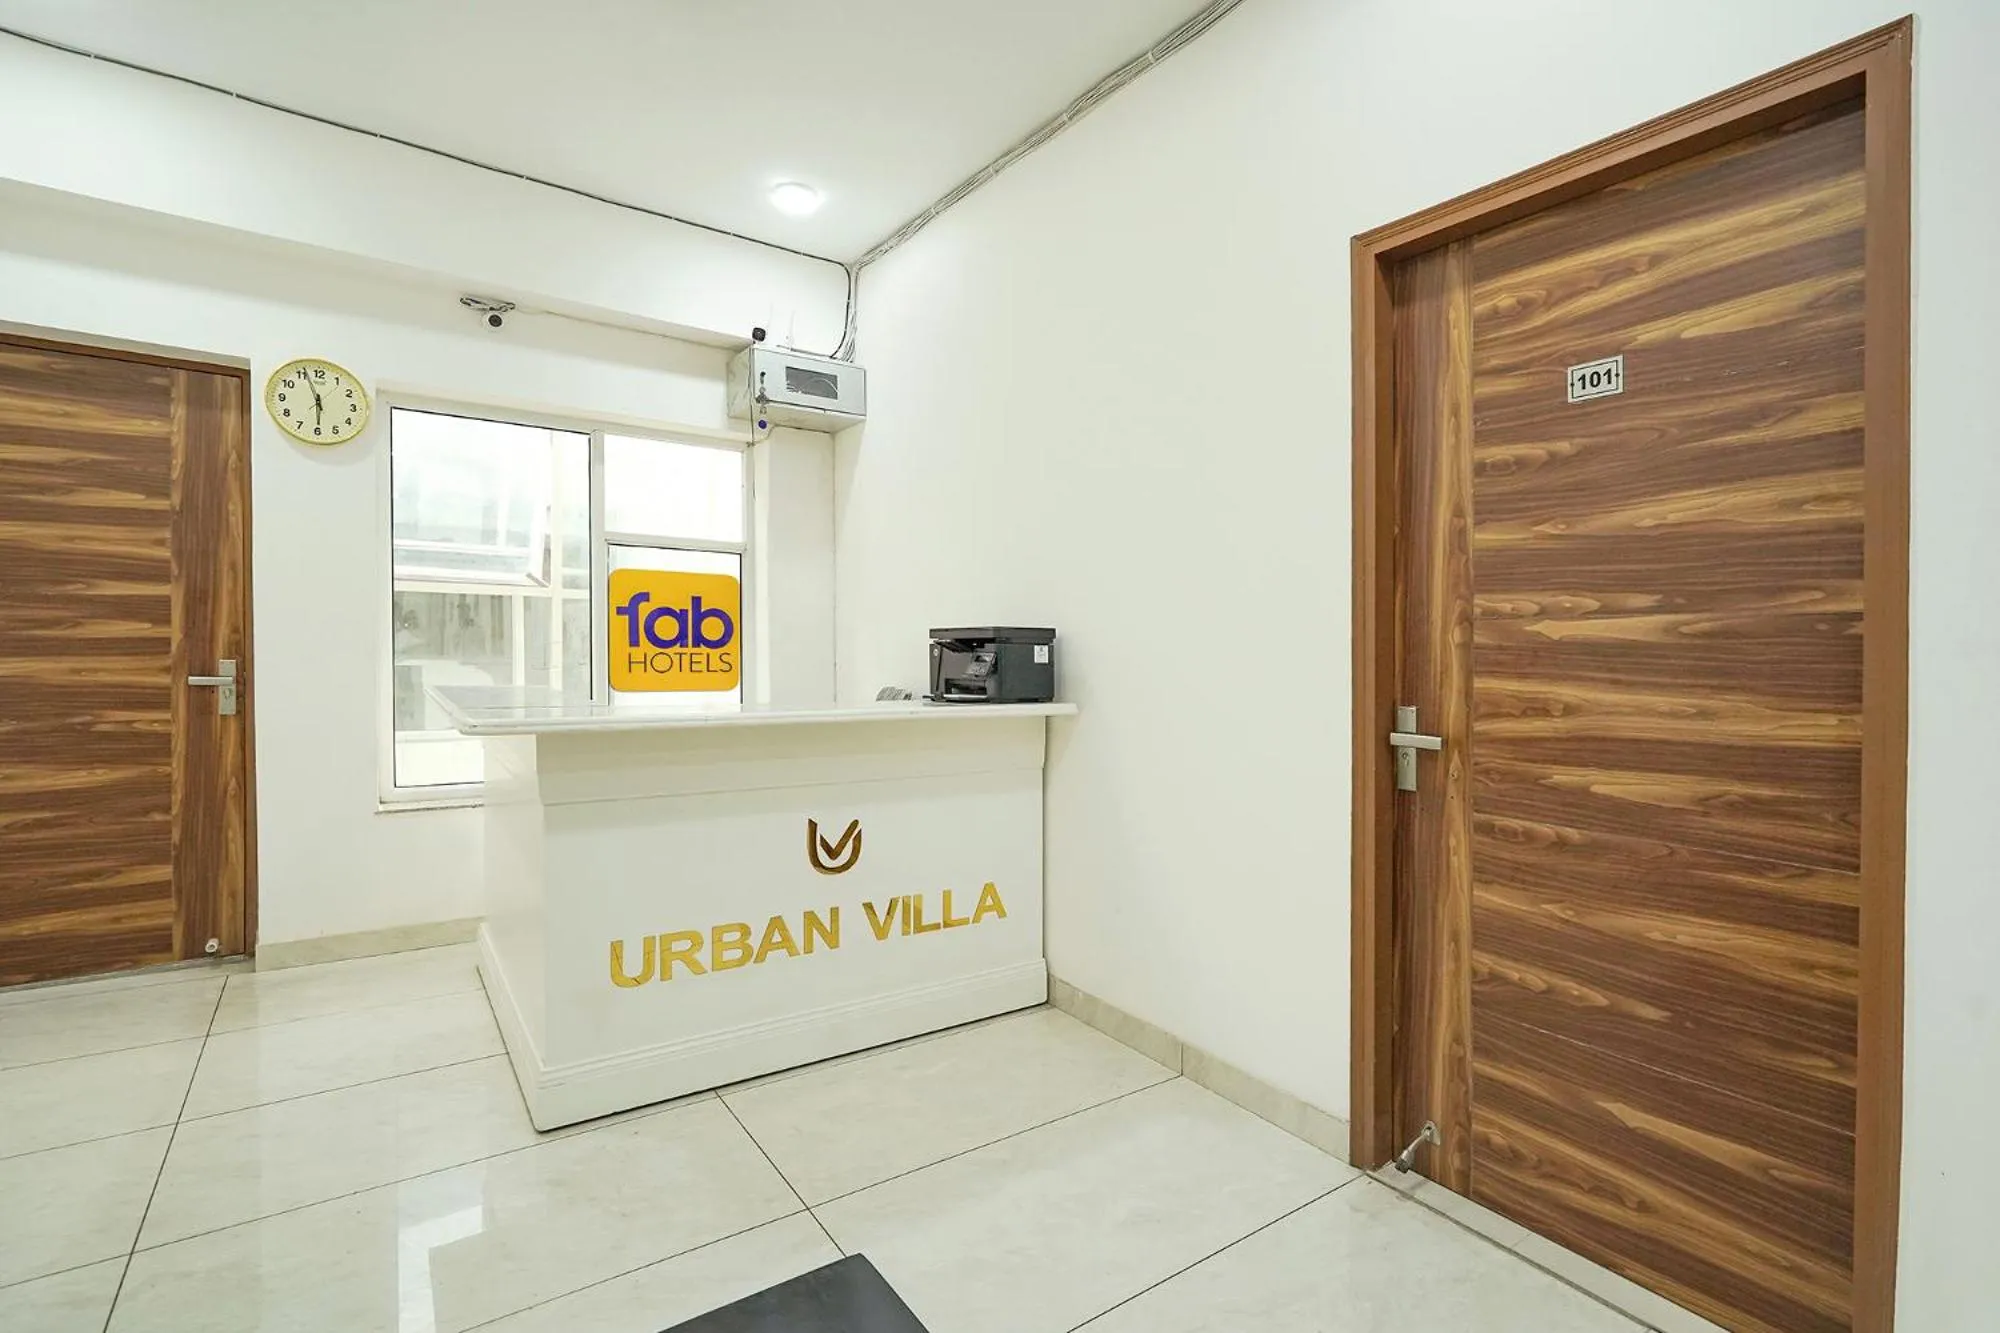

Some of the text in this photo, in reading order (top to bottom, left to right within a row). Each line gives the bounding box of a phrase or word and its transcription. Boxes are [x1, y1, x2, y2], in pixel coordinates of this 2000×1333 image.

[296, 369, 307, 380] 11
[313, 369, 326, 380] 12
[1578, 368, 1612, 390] 101
[282, 379, 295, 389] 10
[334, 376, 340, 386] 1
[278, 393, 286, 402] 9
[345, 388, 353, 398] 2
[282, 408, 291, 417] 8
[350, 403, 357, 413] 3
[296, 420, 304, 430] 7
[344, 417, 352, 426] 4
[314, 427, 322, 436] 6
[332, 425, 340, 435] 5
[616, 591, 734, 649] fab
[628, 651, 733, 674] HOTELS
[610, 881, 1007, 988] URBAN VILLA
